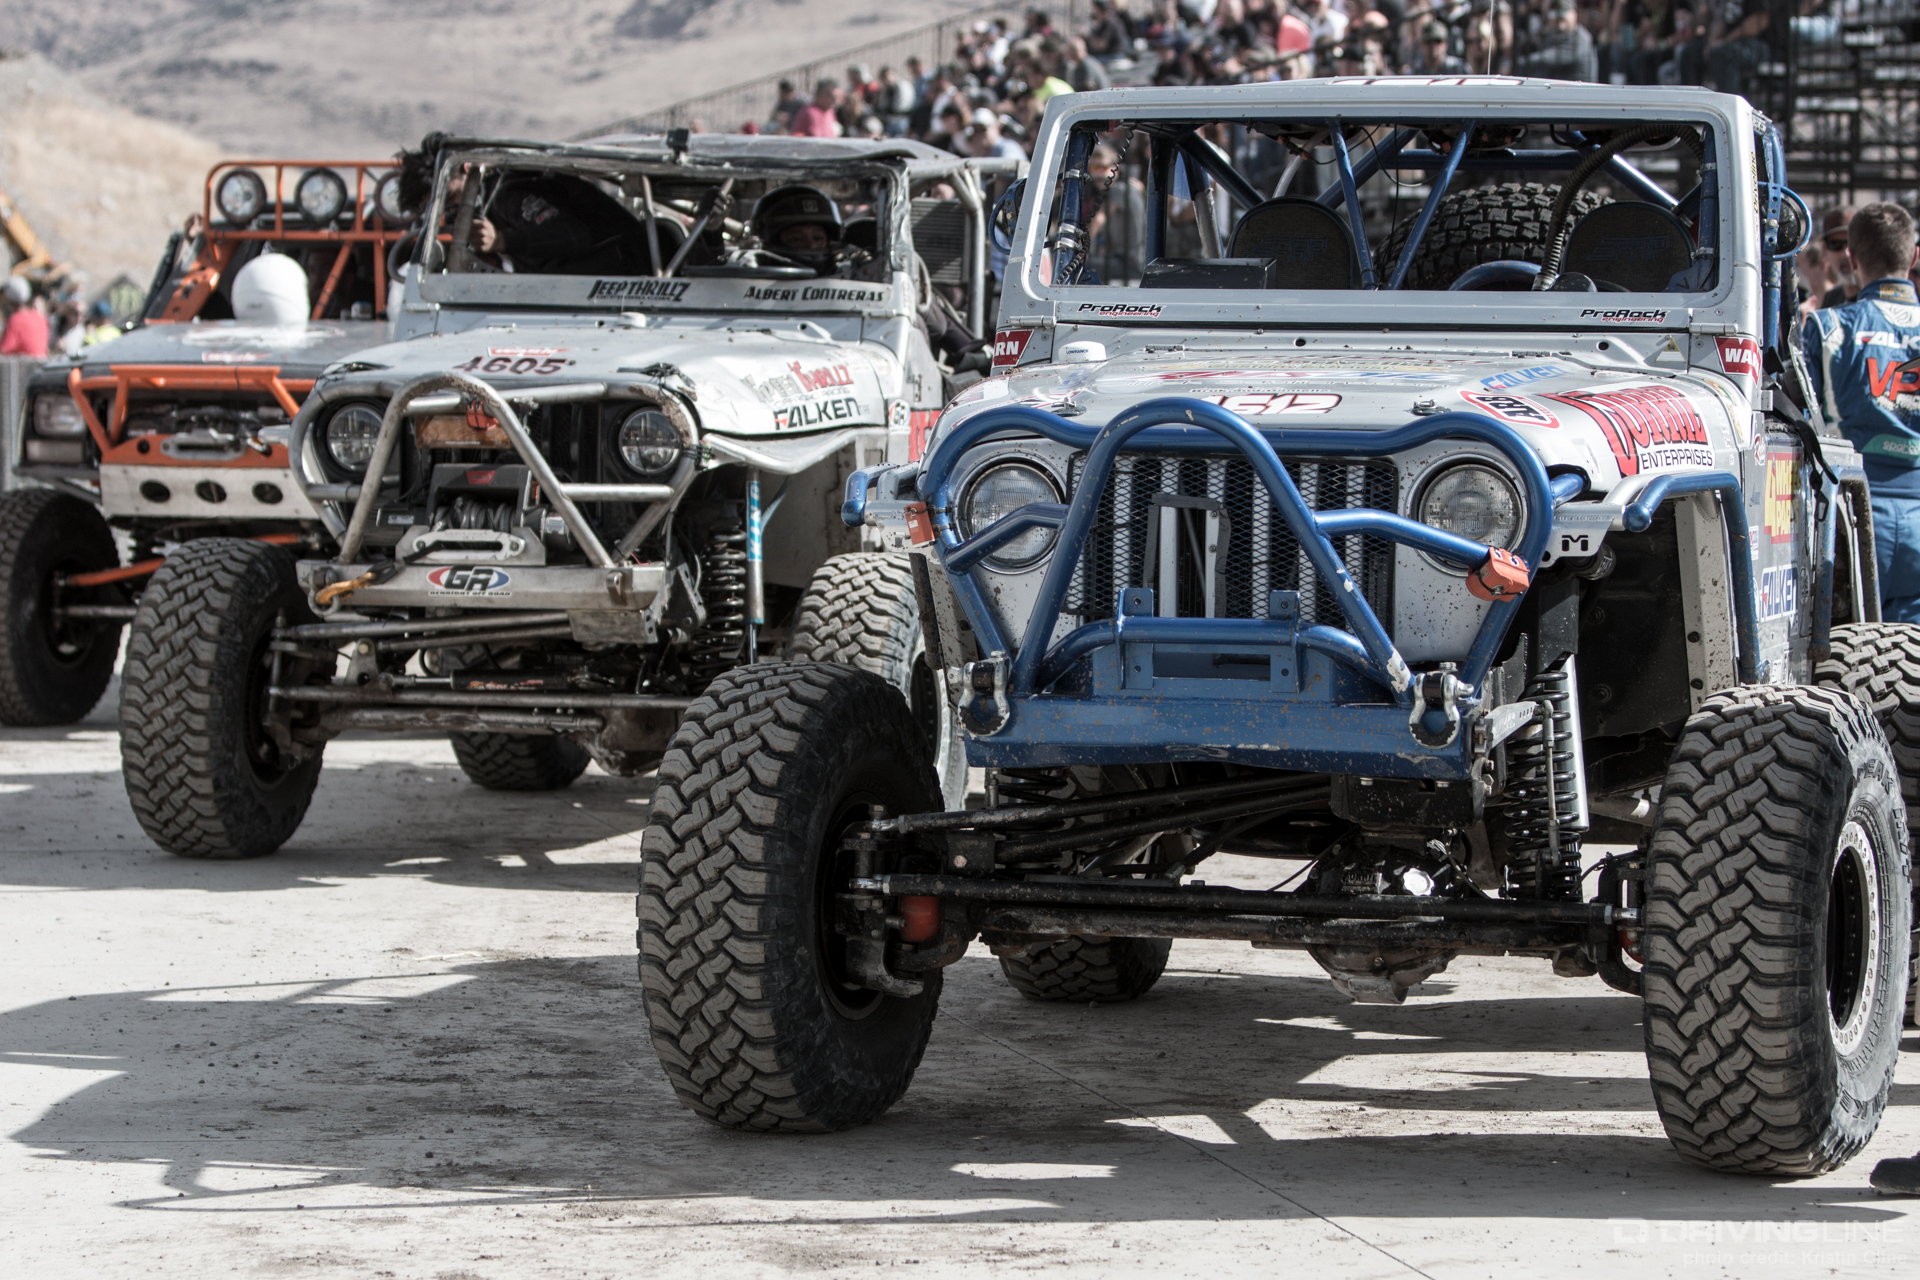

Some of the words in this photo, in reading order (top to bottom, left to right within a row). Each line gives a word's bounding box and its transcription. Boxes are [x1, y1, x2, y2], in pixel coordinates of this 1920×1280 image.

[745, 286, 798, 301] ALBERT
[802, 287, 883, 302] CONTRERAS
[1078, 303, 1162, 313] ProRock
[1580, 309, 1667, 319] ProRock
[452, 356, 568, 375] 4605
[1480, 365, 1568, 391] FALKEN
[1867, 358, 1920, 401] VP
[772, 398, 861, 431] FALKEN
[1642, 449, 1713, 469] ENTERPRISES
[750, 484, 761, 557] KING
[1761, 567, 1799, 618] FALKEN
